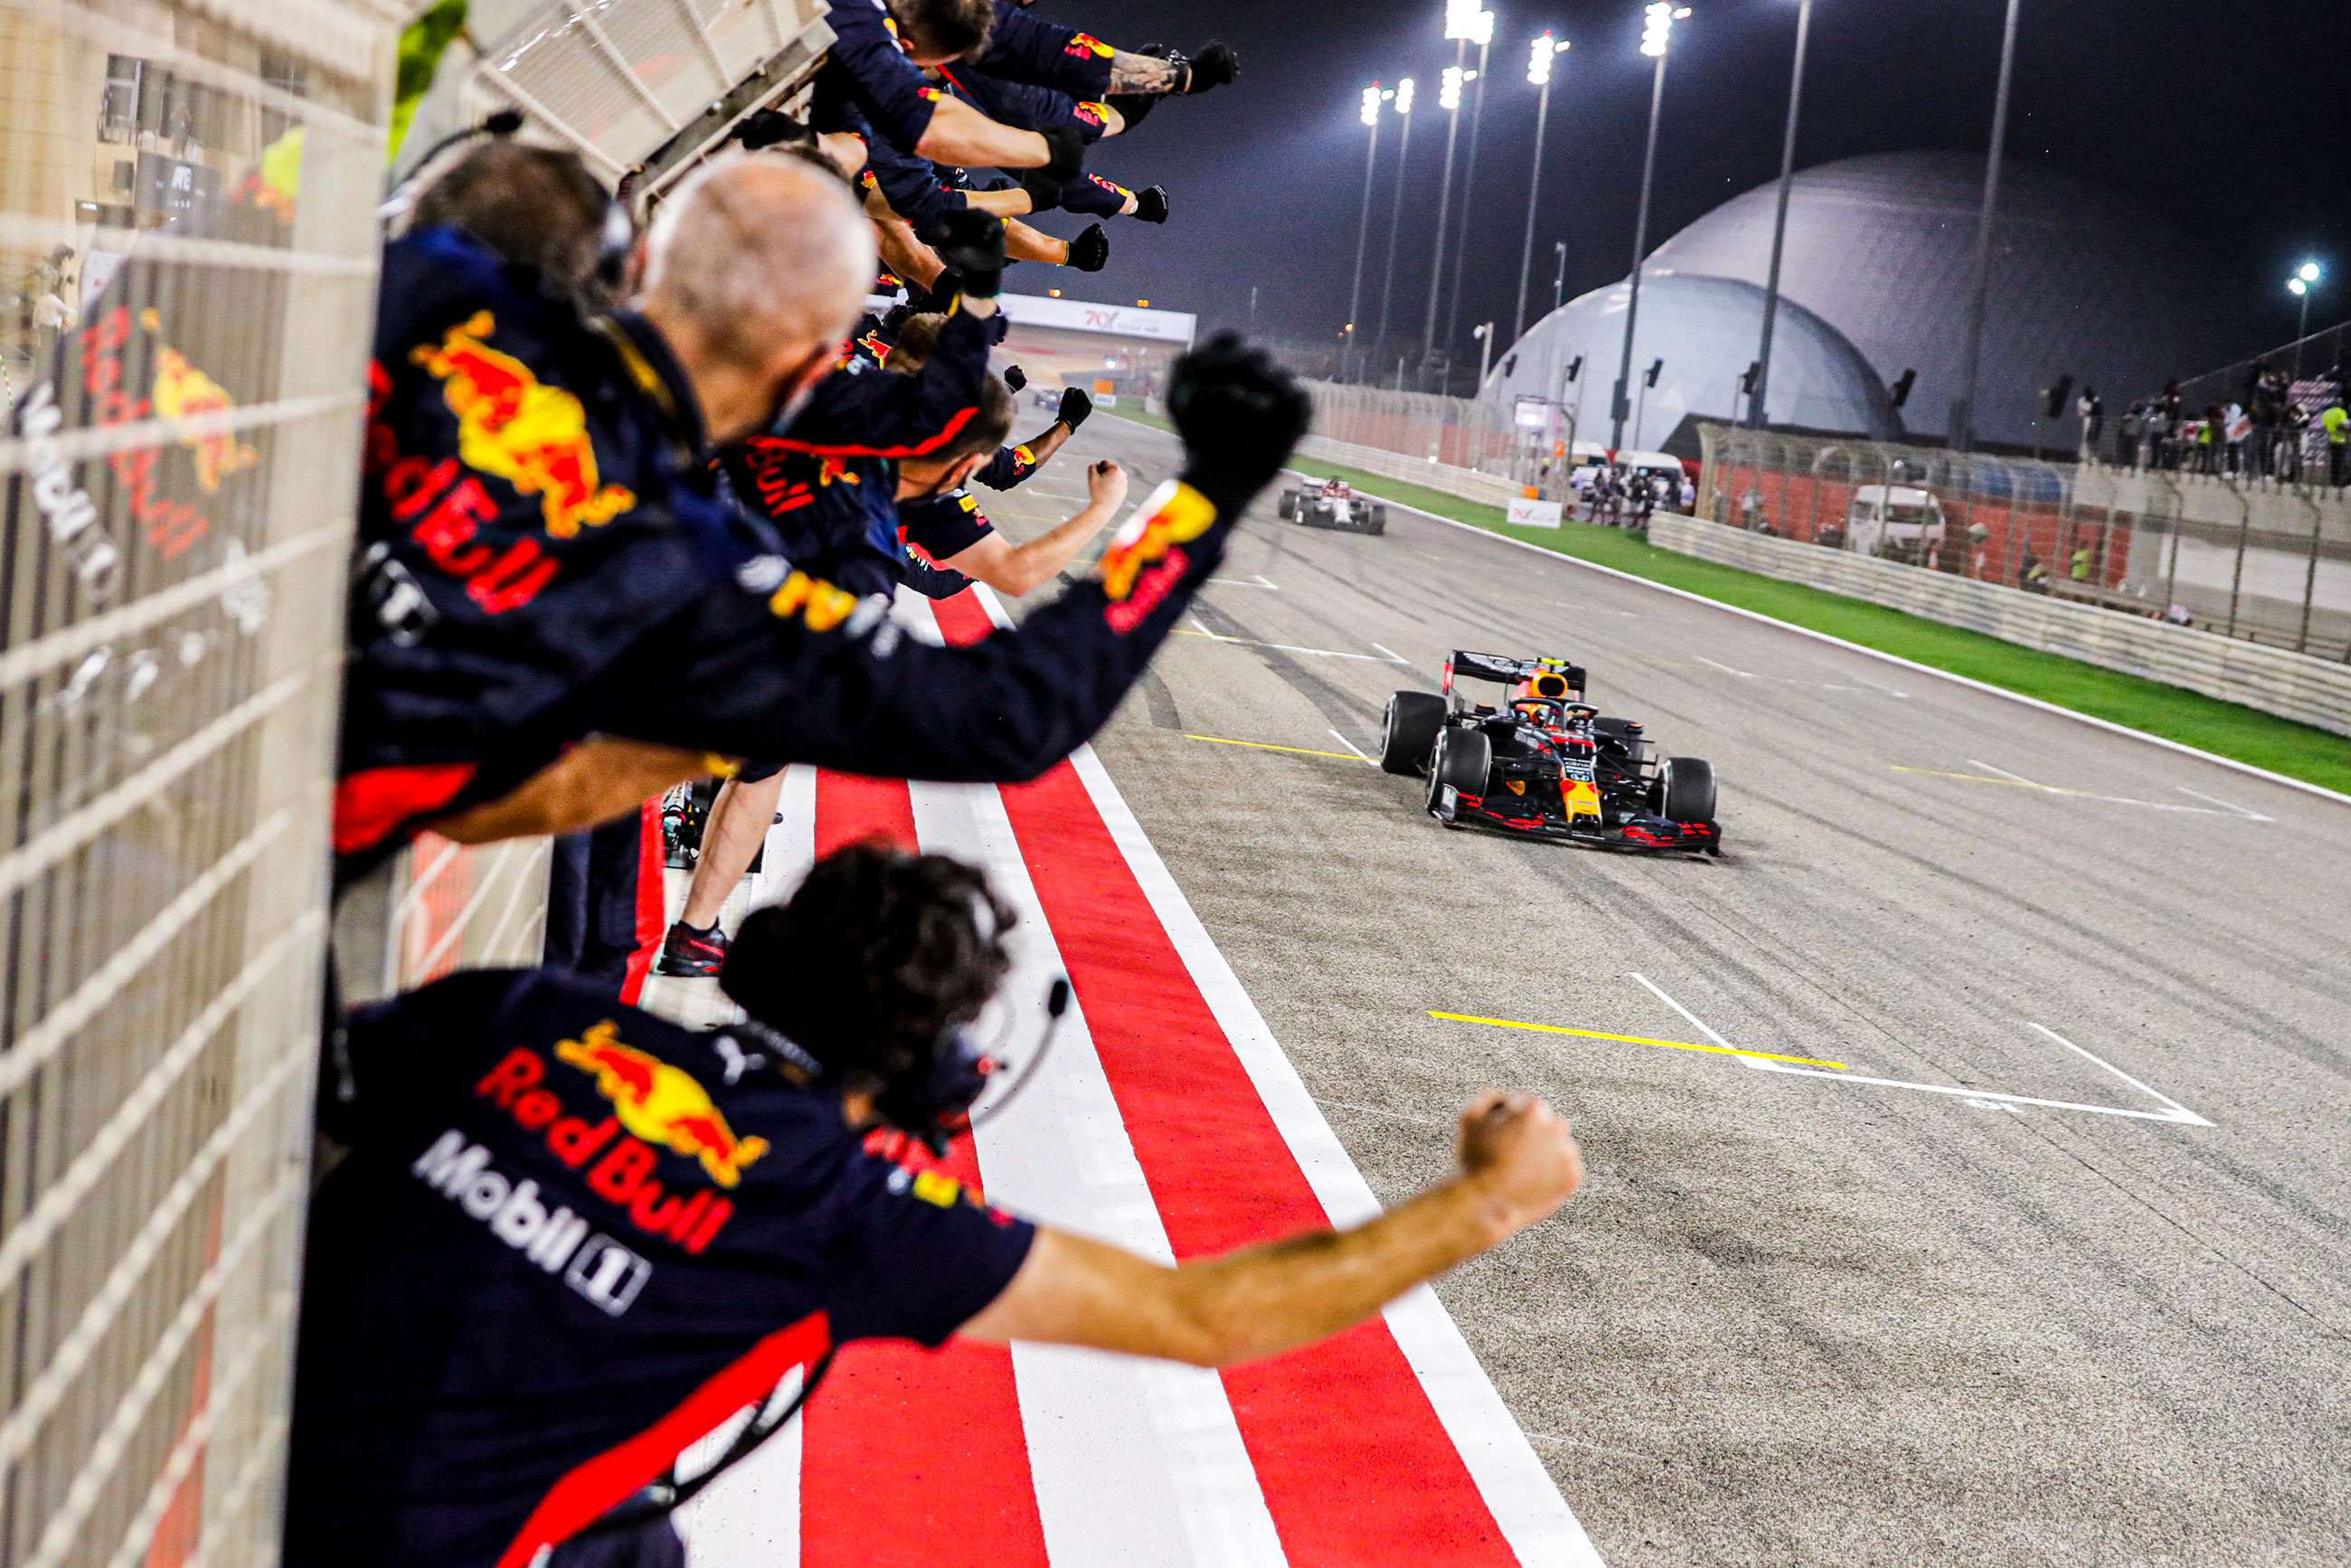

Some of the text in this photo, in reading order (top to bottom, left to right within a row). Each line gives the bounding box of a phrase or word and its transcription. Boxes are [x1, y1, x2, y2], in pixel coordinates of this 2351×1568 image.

[411, 477, 562, 615] Bull
[411, 1129, 590, 1274] Mobil
[474, 1045, 622, 1169] Red
[586, 1135, 734, 1256] Bull
